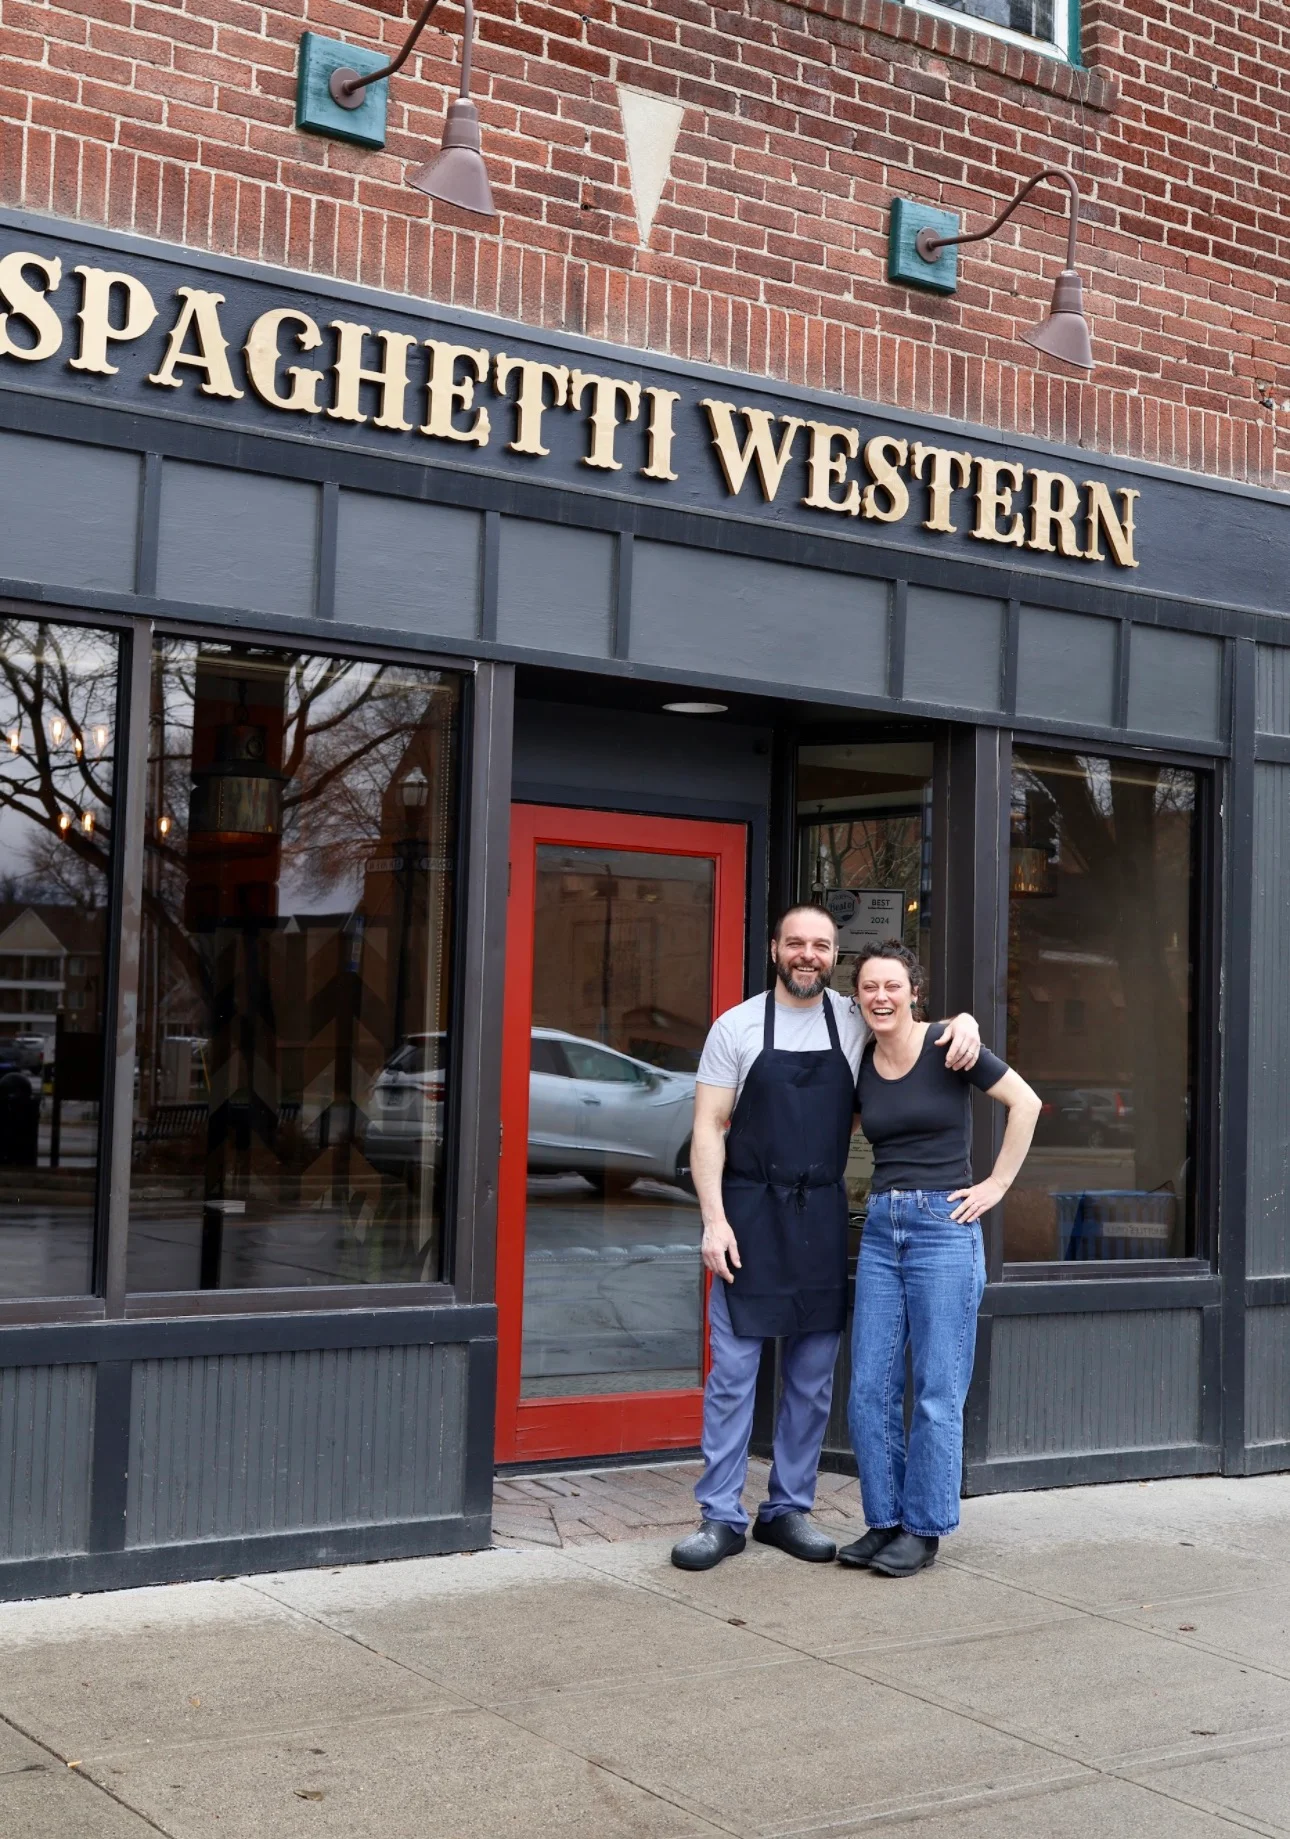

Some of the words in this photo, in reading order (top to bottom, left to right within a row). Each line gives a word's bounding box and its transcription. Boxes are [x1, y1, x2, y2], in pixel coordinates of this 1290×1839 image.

[0, 250, 682, 482] SPAGHETTI
[698, 398, 1141, 568] WESTERN
[870, 916, 889, 924] 2024
